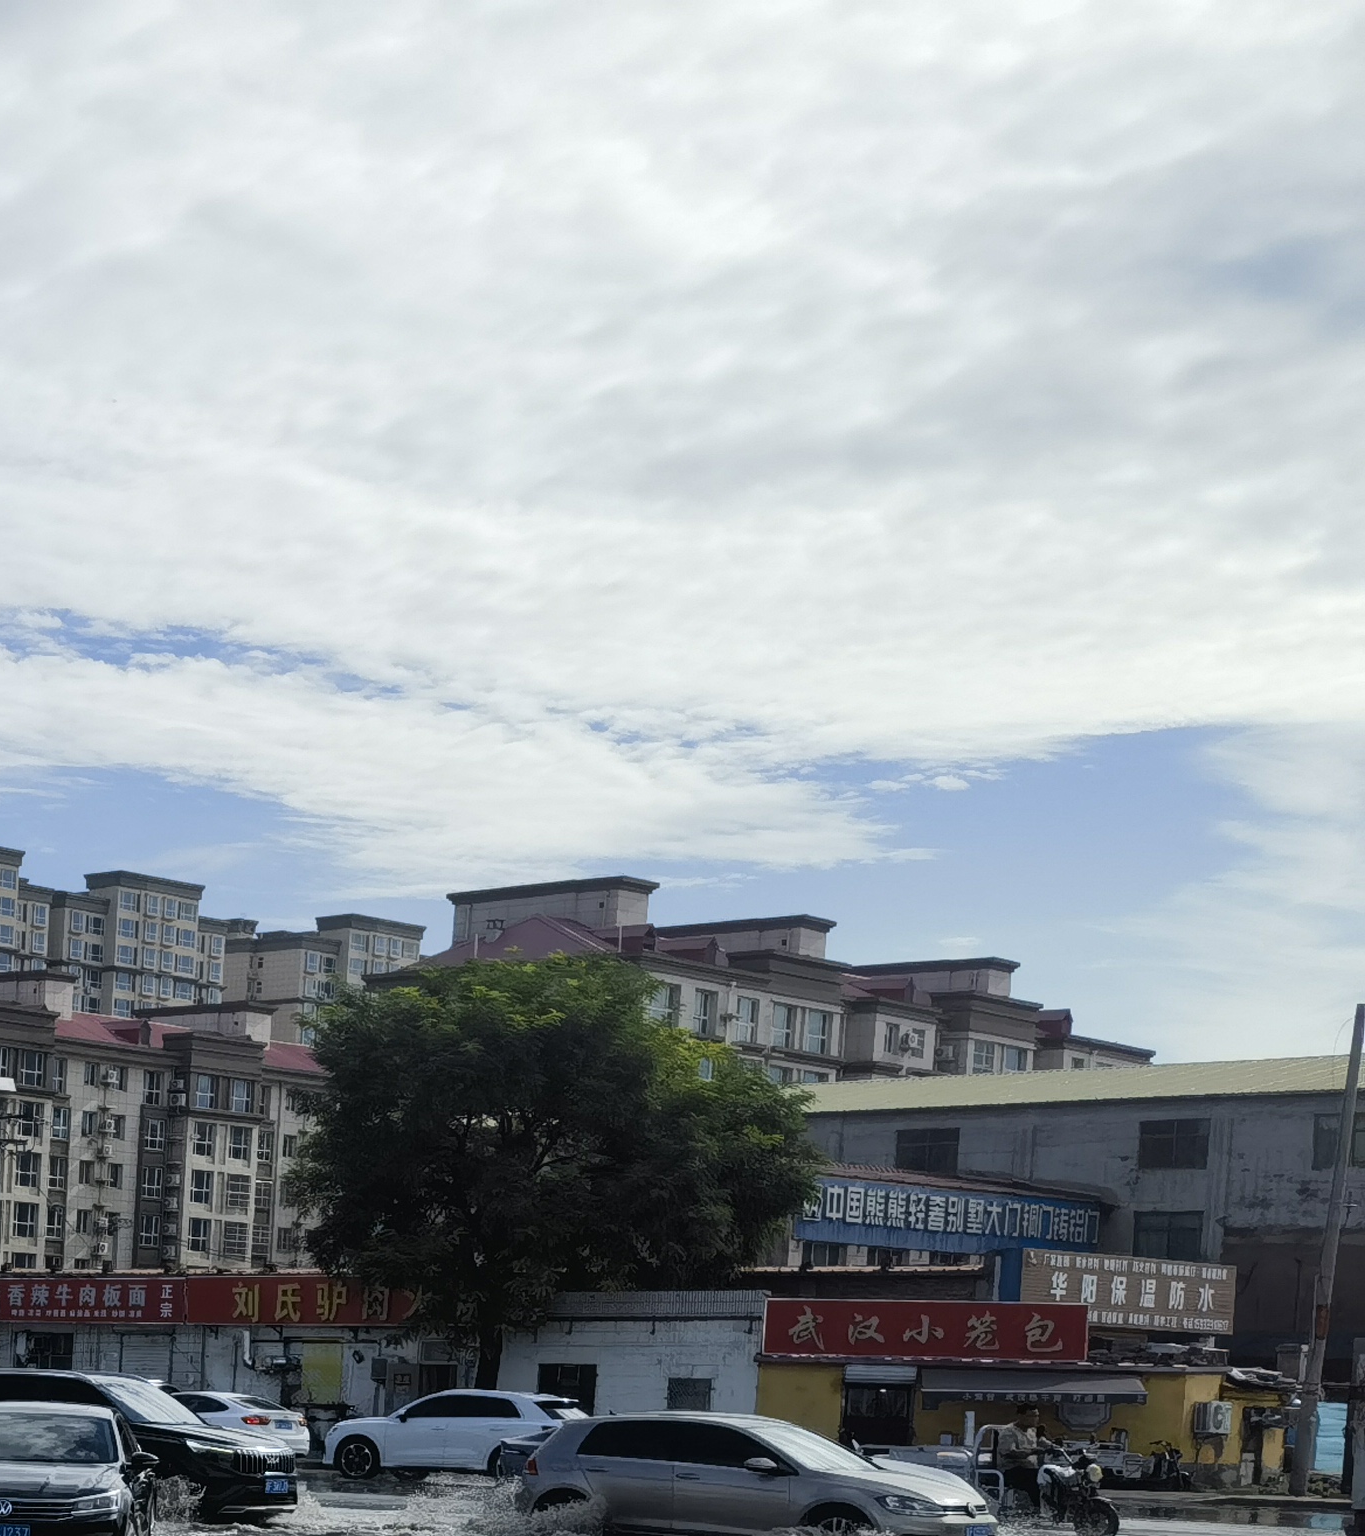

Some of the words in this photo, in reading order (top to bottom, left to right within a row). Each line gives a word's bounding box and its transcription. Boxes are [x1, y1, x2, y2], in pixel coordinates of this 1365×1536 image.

[7, 1283, 148, 1307] 香辣牛肉板面
[160, 1284, 174, 1318] 正宗
[1050, 1271, 1215, 1312] 华阳保温防水
[787, 1305, 1064, 1353] 武汉小笼包
